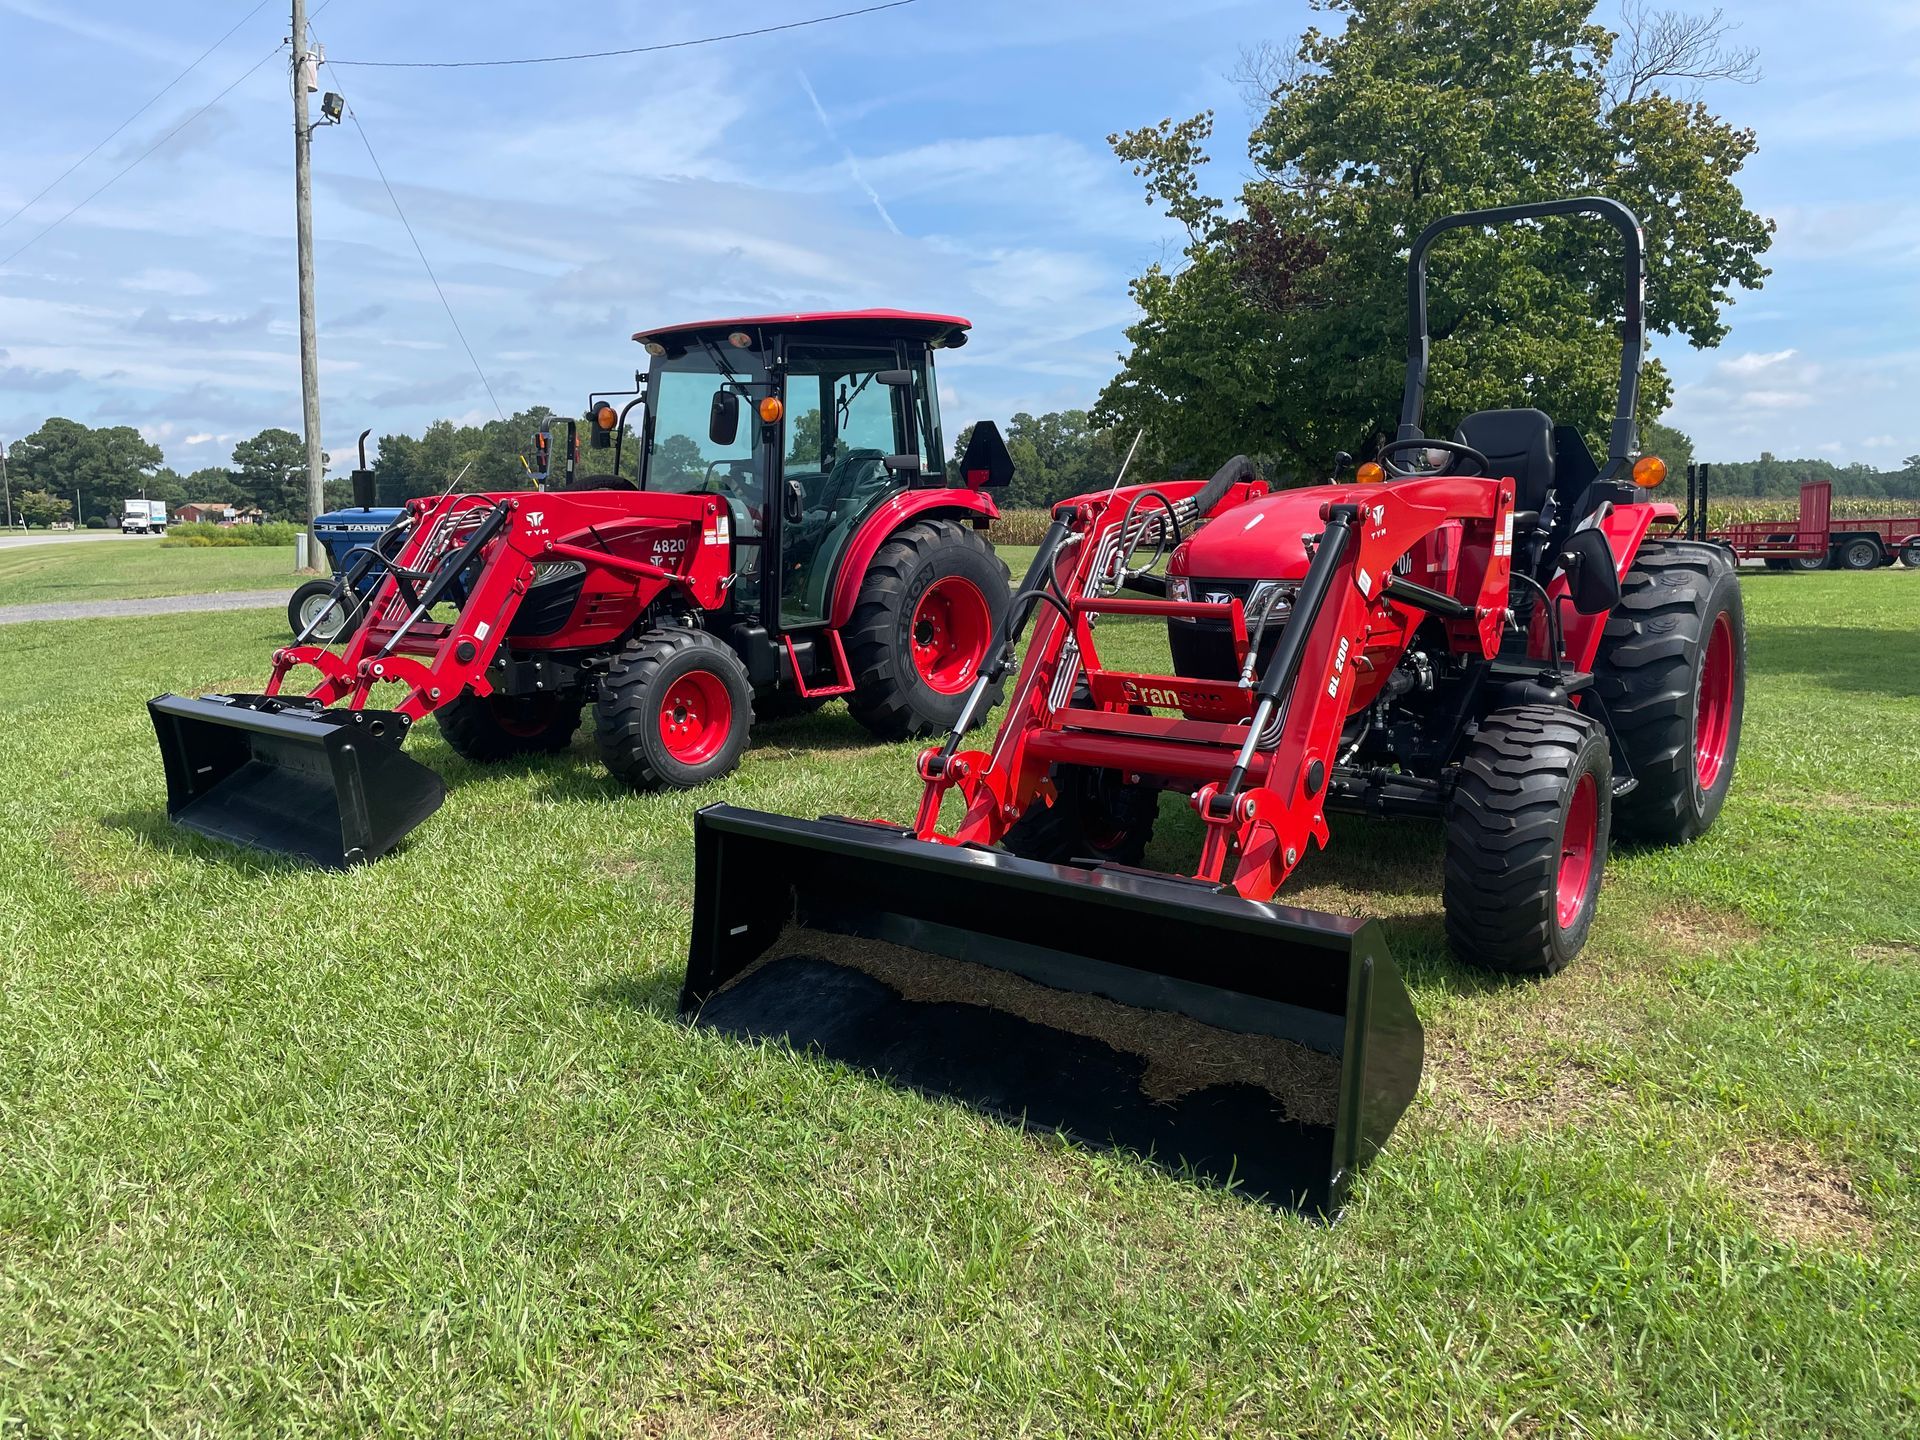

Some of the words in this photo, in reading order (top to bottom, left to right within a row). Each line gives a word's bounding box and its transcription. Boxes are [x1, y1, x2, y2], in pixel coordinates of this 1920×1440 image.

[652, 538, 689, 554] 4820
[1371, 528, 1386, 540] TYM
[1327, 675, 1340, 699] BL
[1335, 636, 1349, 674] 200
[1121, 679, 1227, 711] Branson
